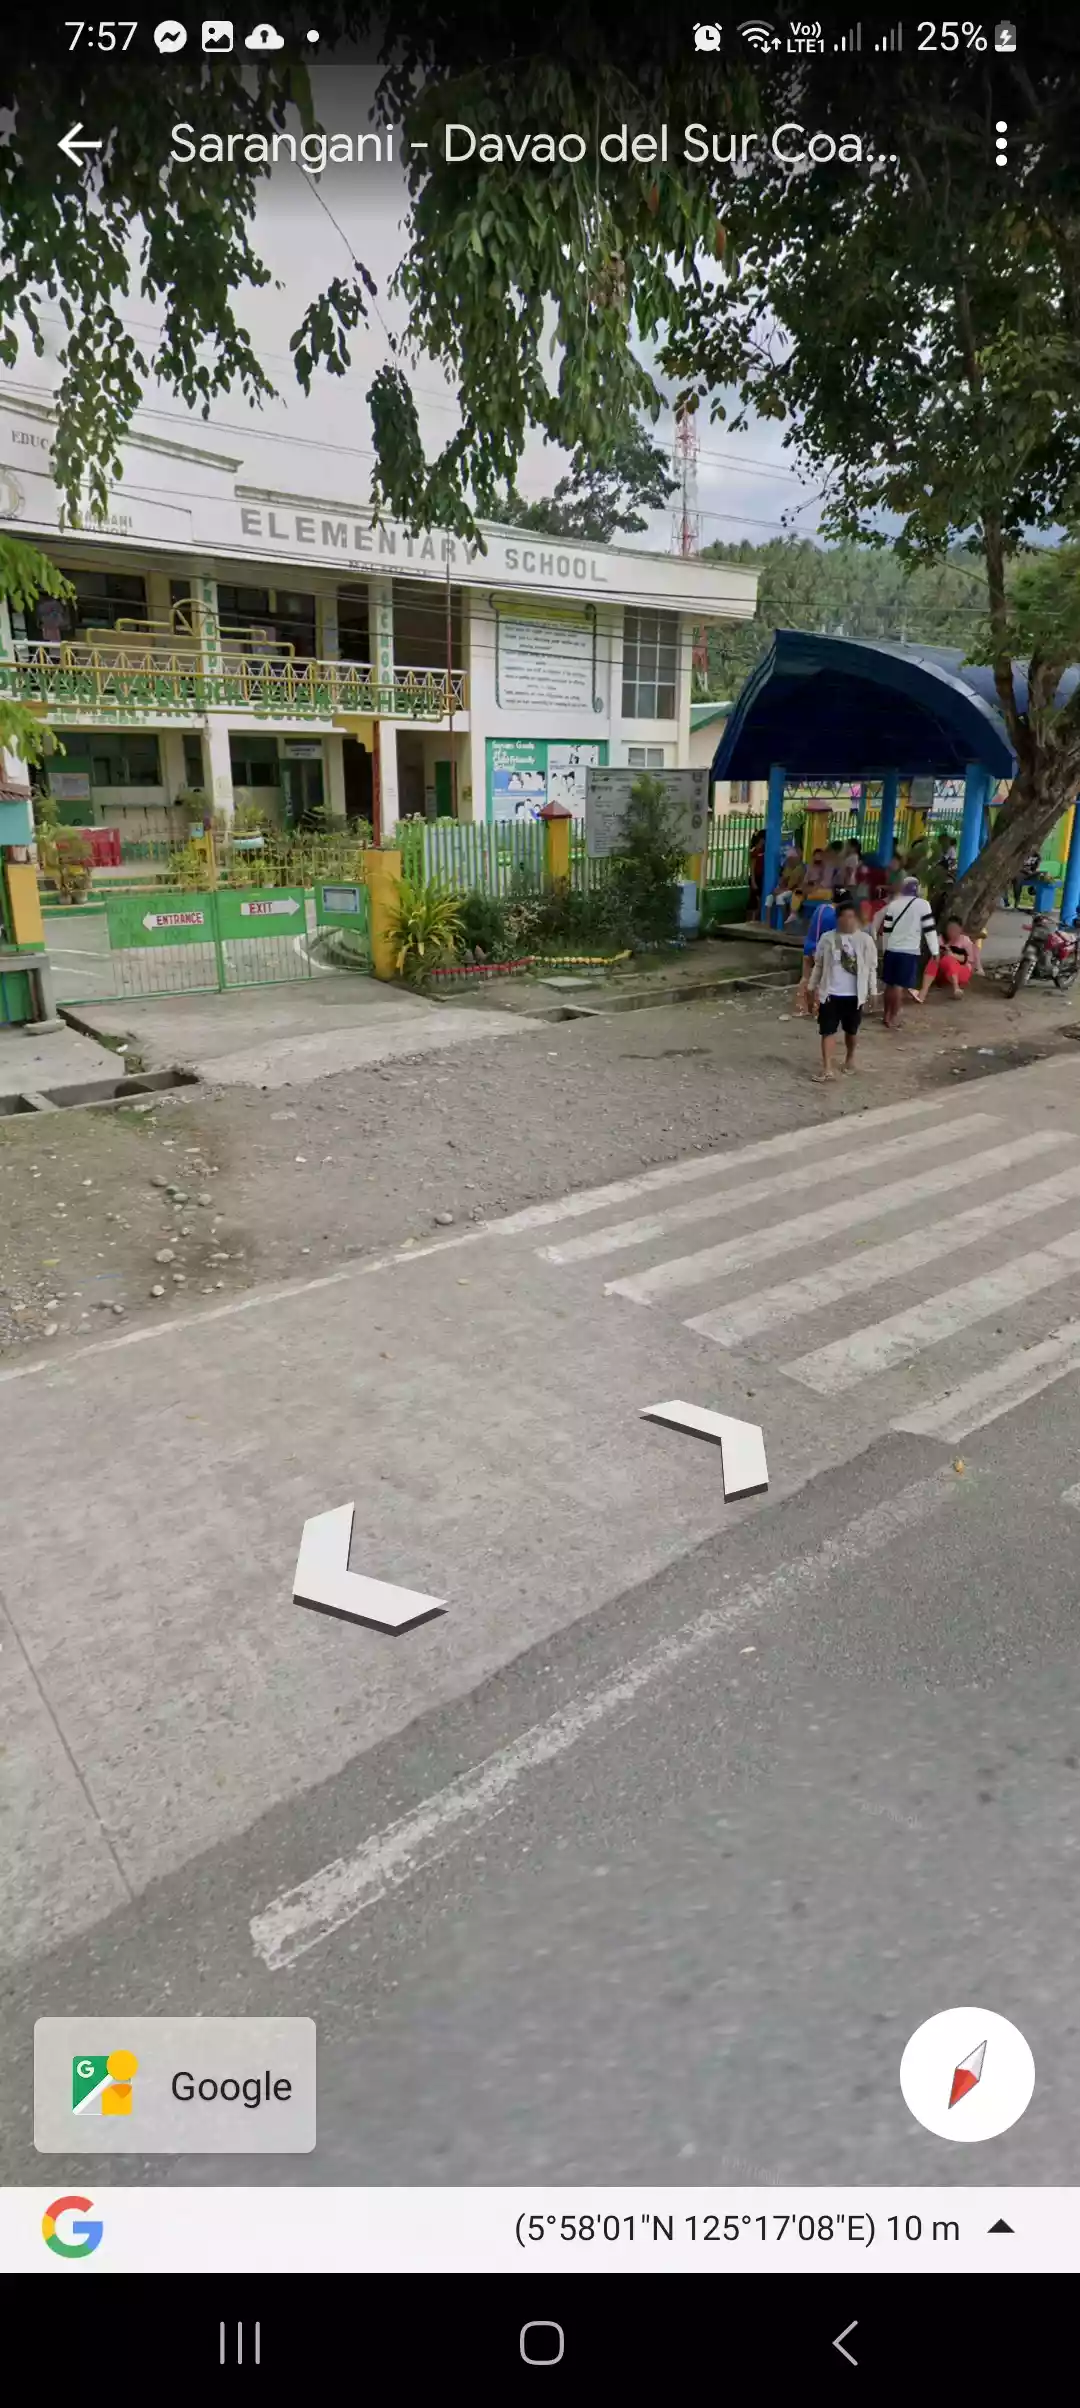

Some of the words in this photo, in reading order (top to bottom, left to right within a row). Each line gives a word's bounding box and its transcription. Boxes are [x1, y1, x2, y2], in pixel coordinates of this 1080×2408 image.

[11, 430, 50, 449] EDUC
[240, 507, 475, 566] ELEMENTARY
[505, 548, 608, 583] SCHOOL
[249, 902, 273, 914] EXIT
[156, 912, 203, 926] ENTRANCE
